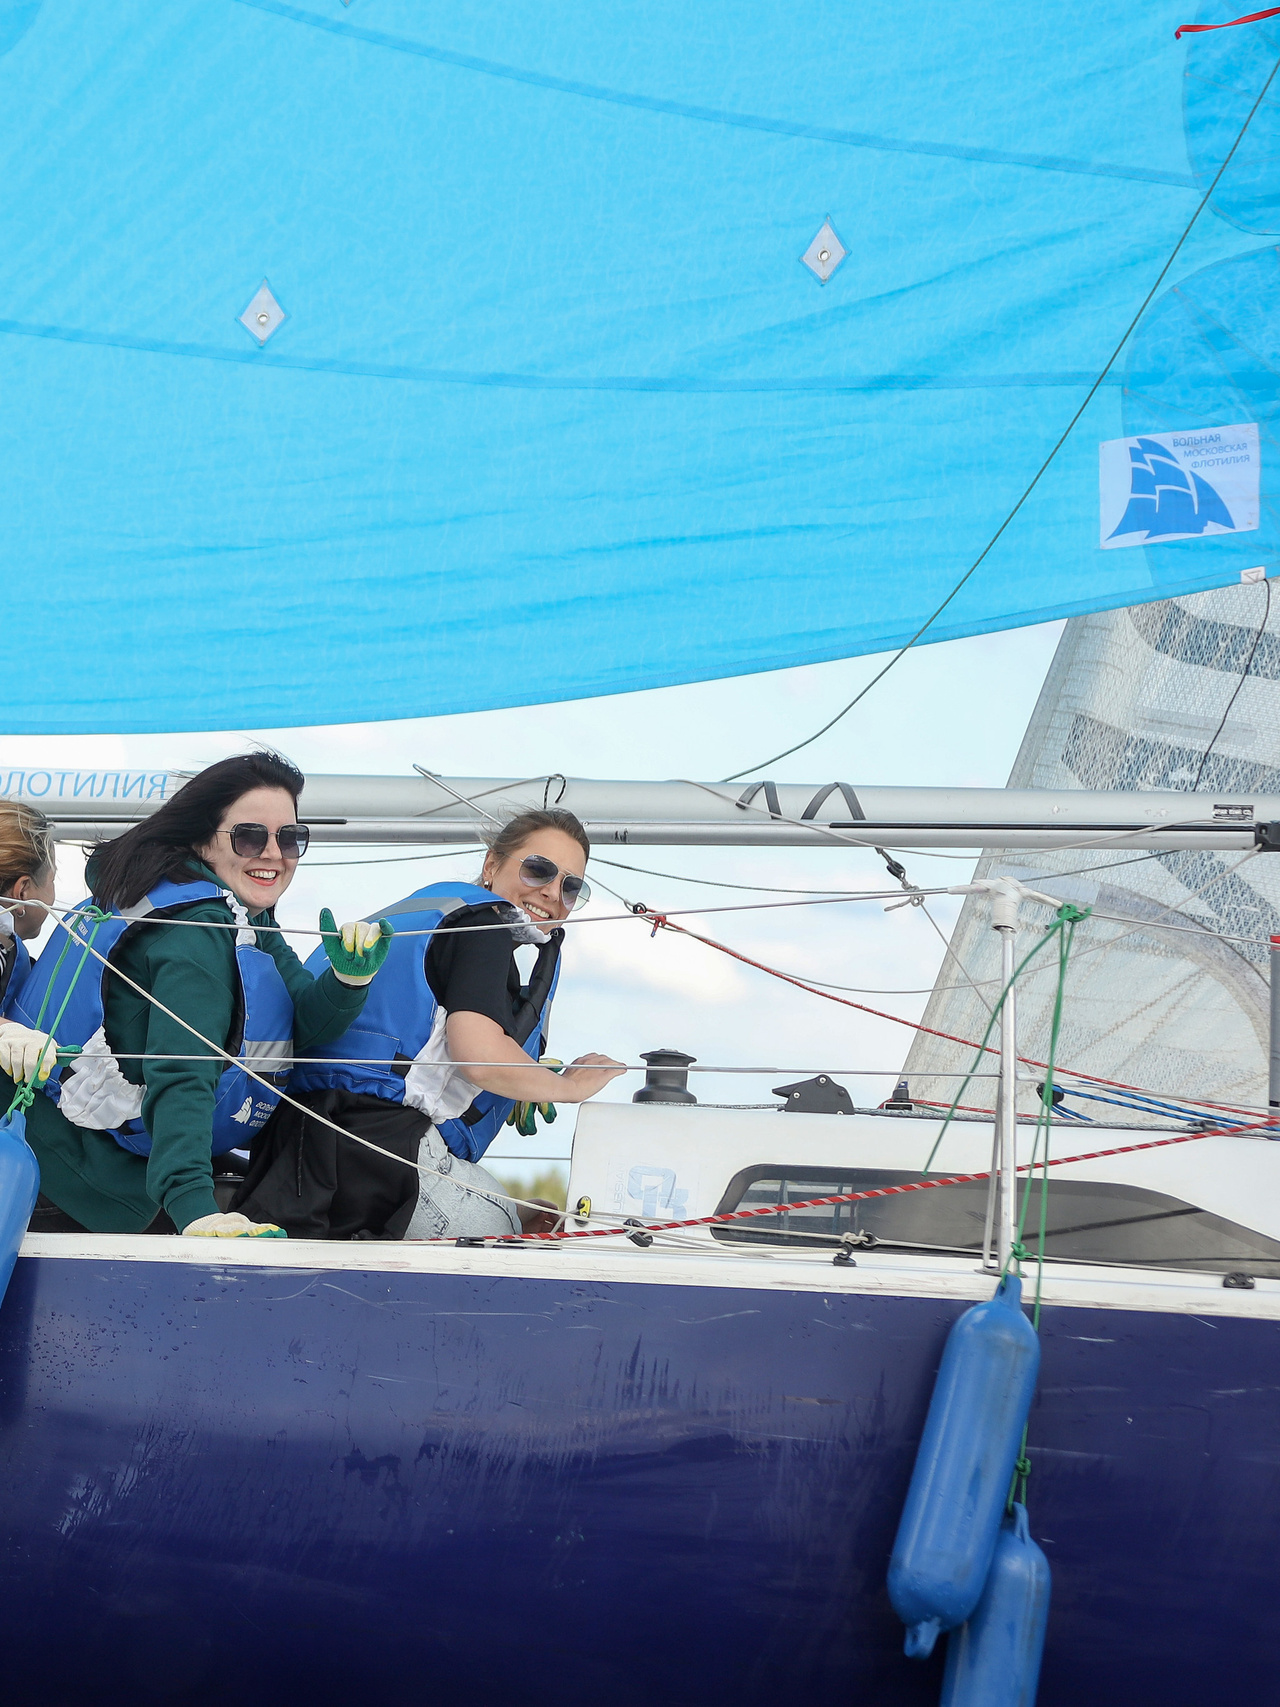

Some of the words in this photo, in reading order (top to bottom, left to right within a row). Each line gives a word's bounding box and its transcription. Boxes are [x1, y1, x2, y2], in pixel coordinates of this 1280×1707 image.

[1172, 433, 1221, 448] ВОЛЬНАЯ
[1183, 443, 1248, 458] МОСКОВСКАЯ
[1191, 454, 1250, 469] ФЛОТИЛИЯ
